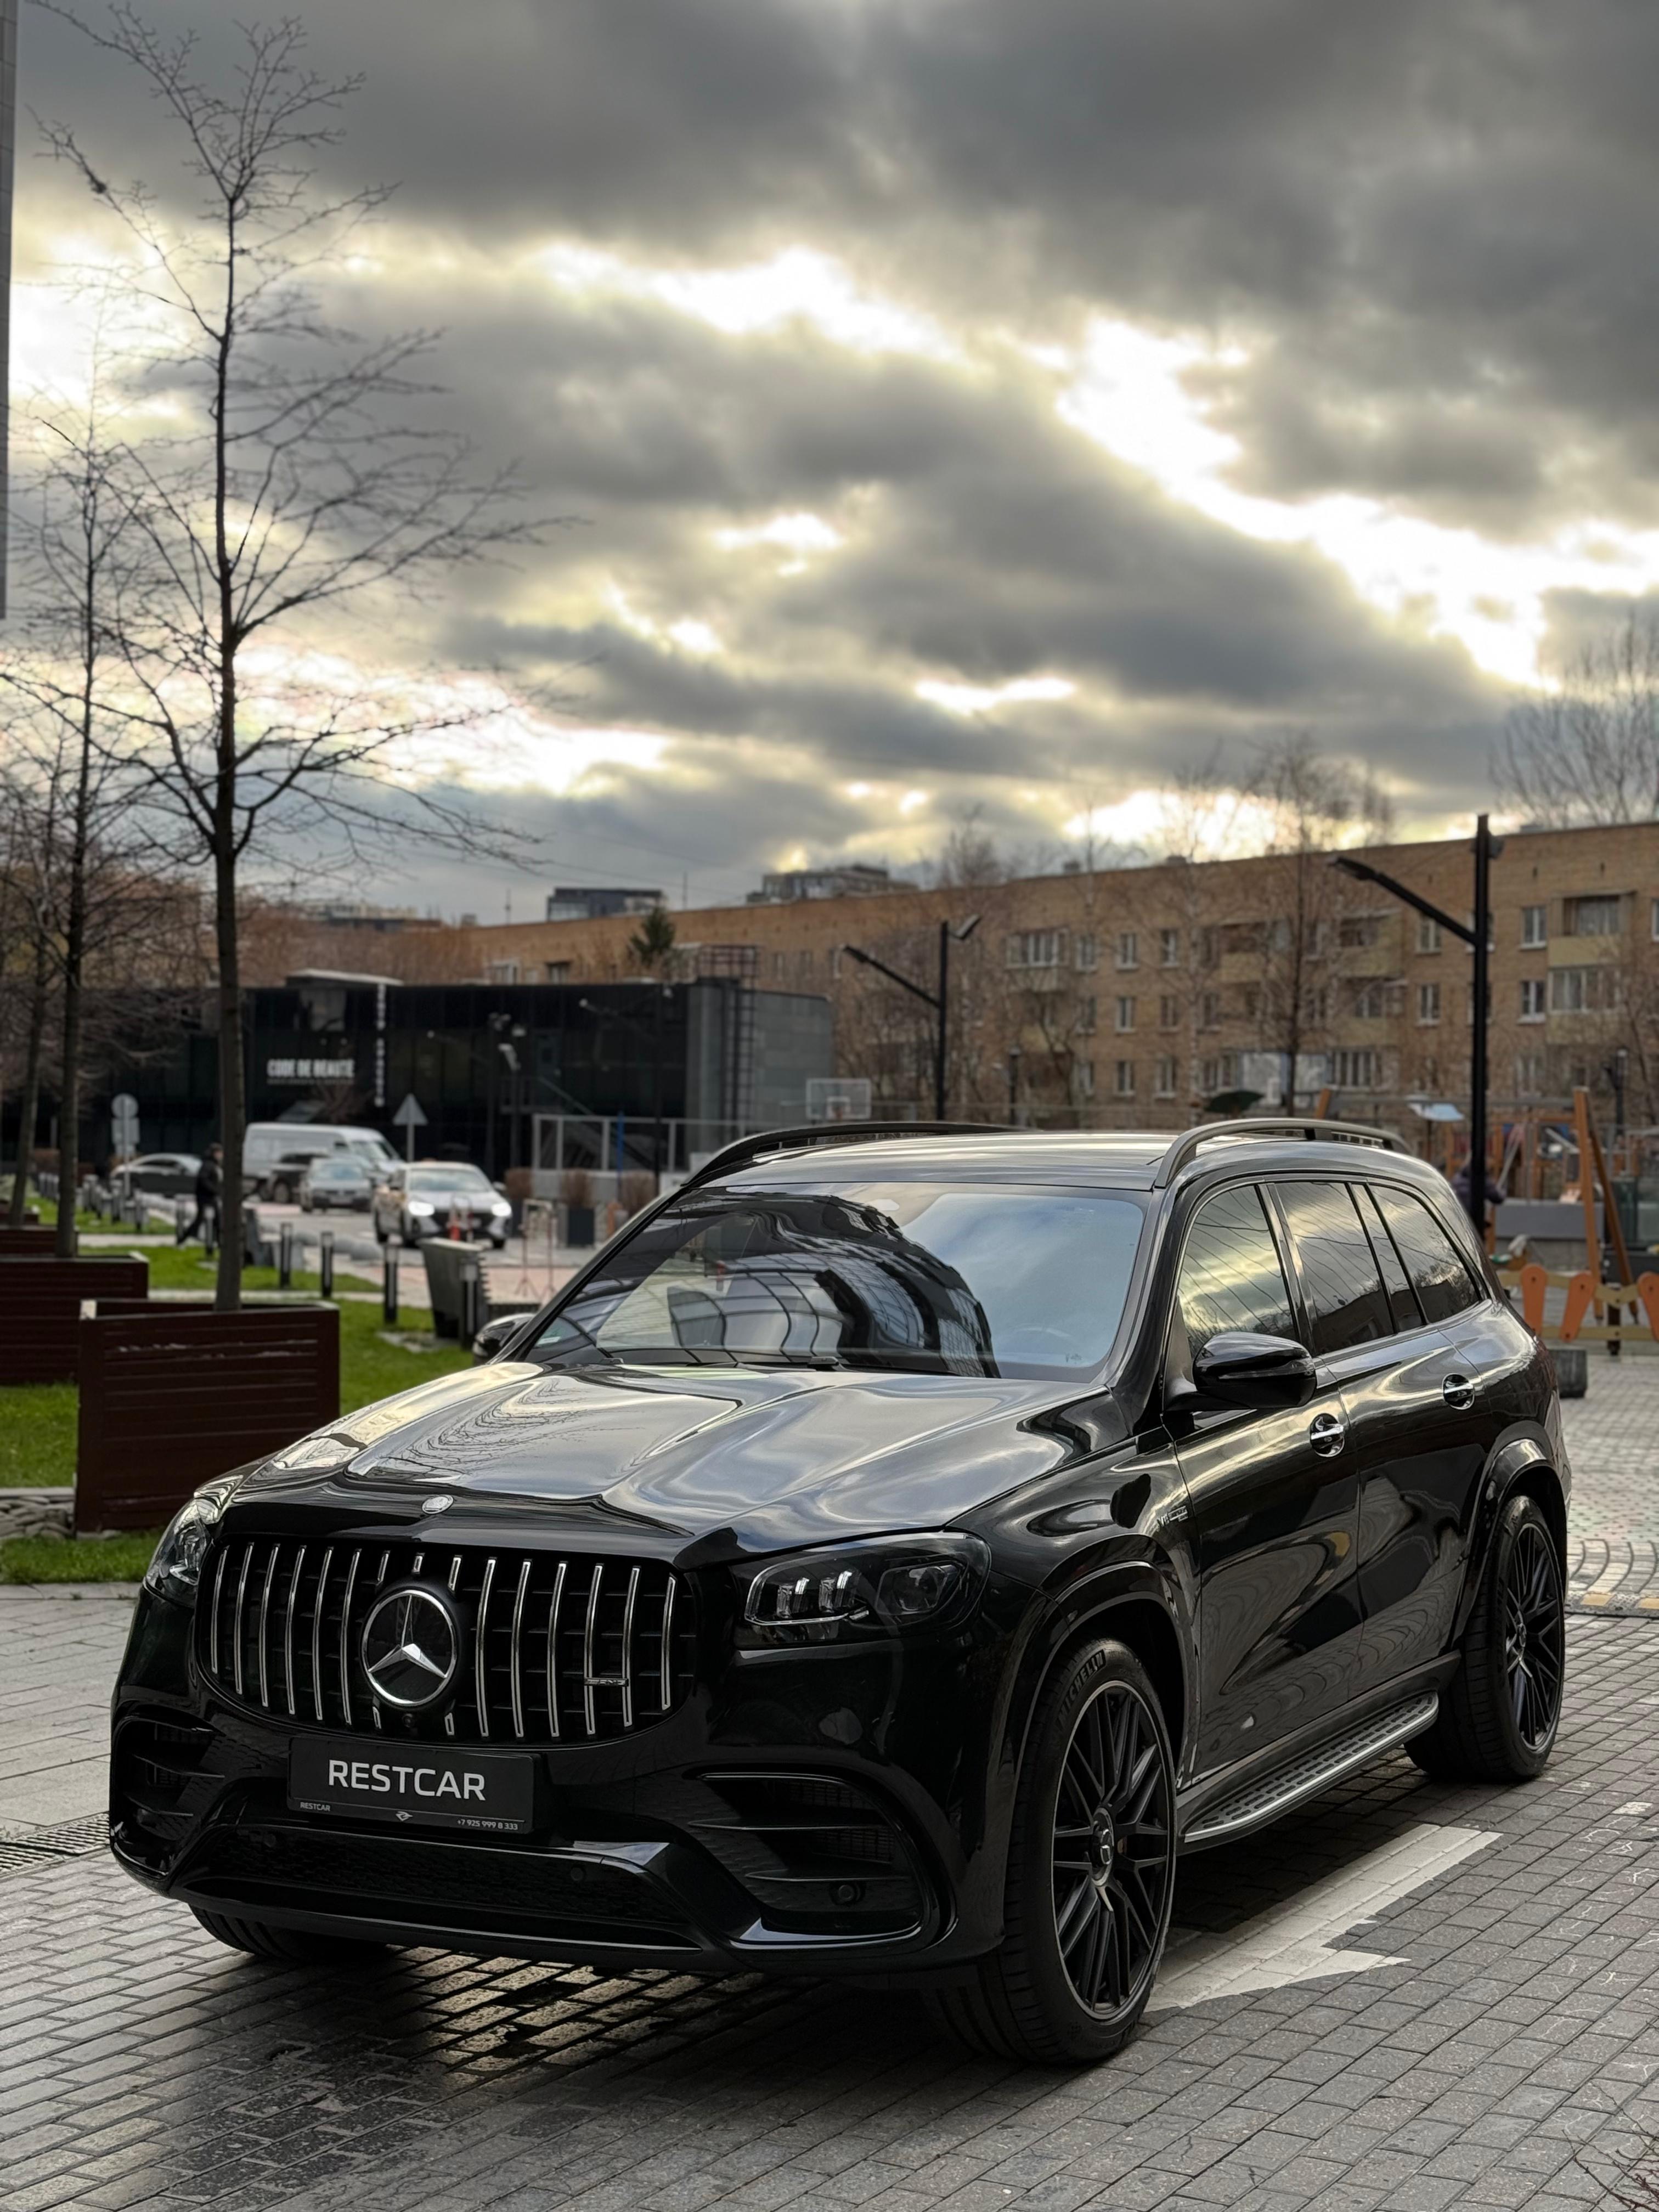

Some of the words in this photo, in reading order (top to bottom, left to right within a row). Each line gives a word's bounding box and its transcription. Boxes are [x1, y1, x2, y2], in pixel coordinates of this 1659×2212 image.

[1058, 1651, 1104, 1729] MICHELIN
[329, 1759, 486, 1801] RESTCAR
[300, 1802, 330, 1812] RESTCAR
